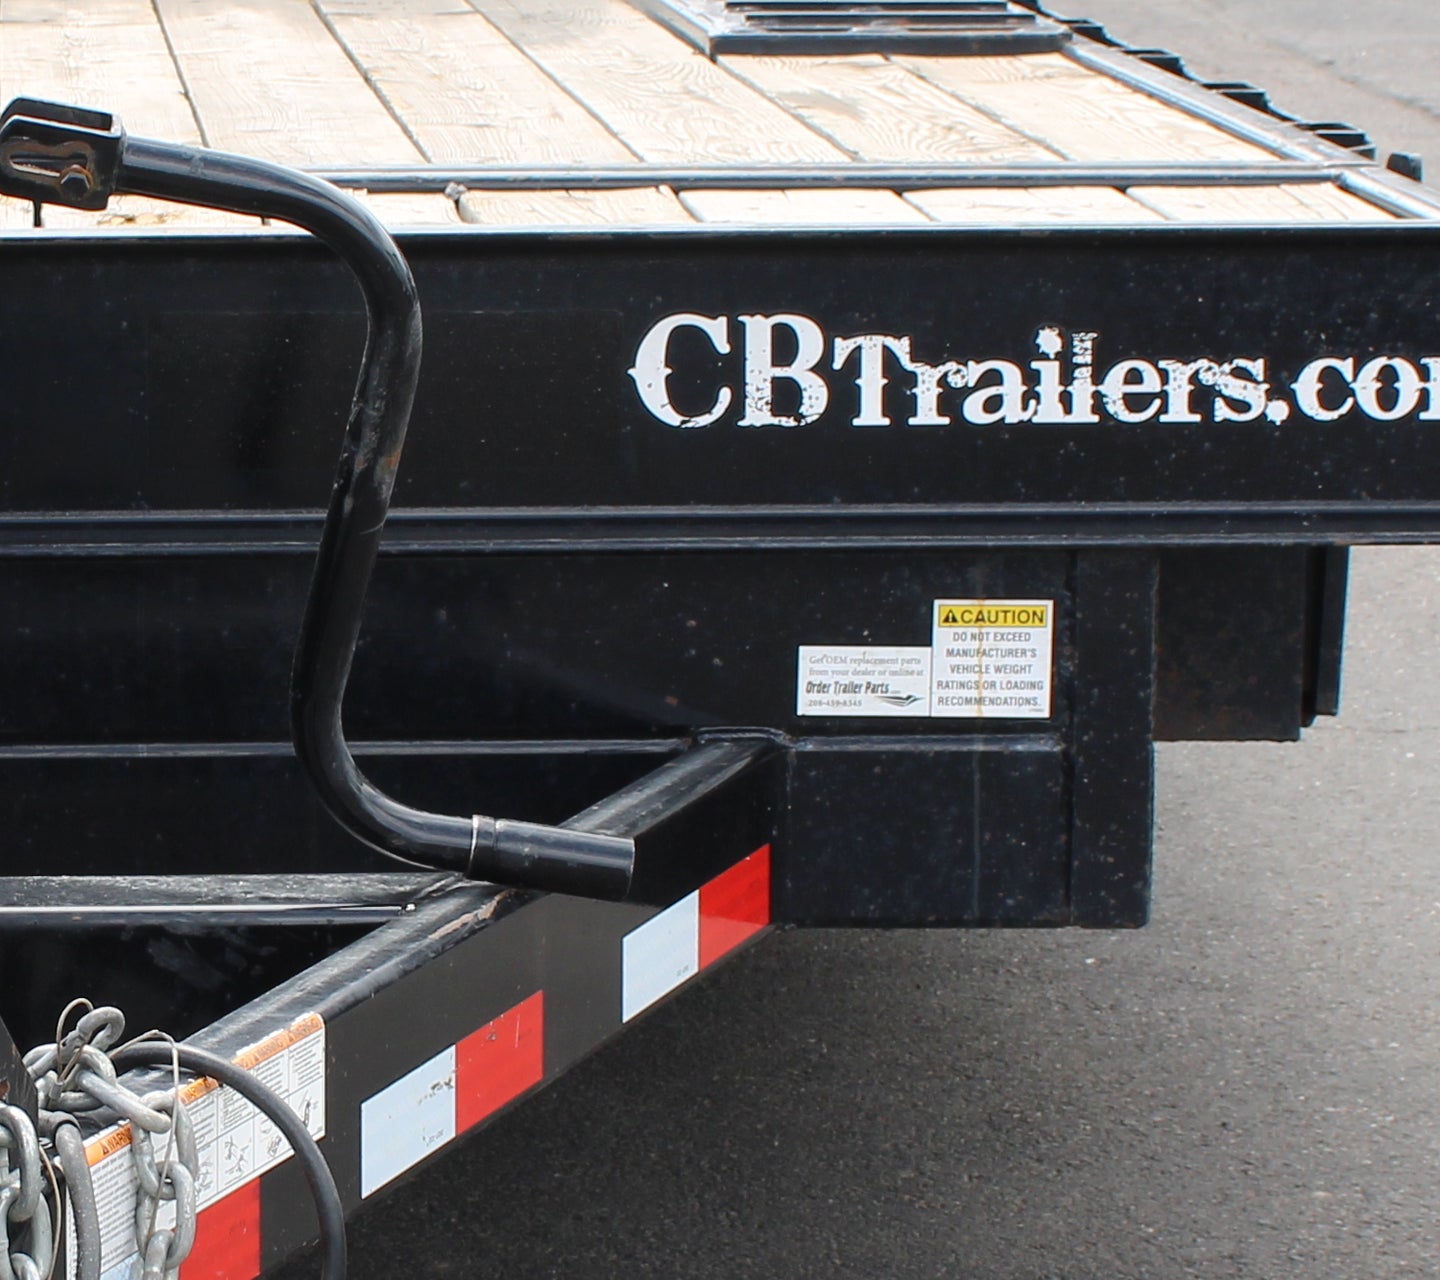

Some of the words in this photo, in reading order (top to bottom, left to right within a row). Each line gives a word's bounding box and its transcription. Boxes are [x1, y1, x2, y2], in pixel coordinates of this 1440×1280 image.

[960, 609, 1045, 624] CAUTION
[953, 632, 967, 642] DO
[970, 632, 991, 642] NOT
[993, 631, 1031, 642] EXCEED
[946, 648, 1037, 658] MANUFACTURER'S
[826, 656, 848, 665] OEM
[850, 655, 900, 667] replacement
[901, 656, 922, 667] parts
[809, 669, 829, 677] from
[830, 670, 850, 679] your
[851, 668, 876, 677] dealer
[879, 669, 887, 677] or
[888, 668, 915, 677] online
[916, 669, 924, 677] at
[949, 664, 991, 674] VEHICLE
[993, 664, 1033, 674] WEIGHT
[806, 681, 831, 694] Order
[833, 681, 863, 695] Trailer
[864, 681, 890, 694] Parts
[937, 680, 980, 690] RATINGS
[982, 680, 997, 690] OR
[1000, 681, 1044, 690] LOADING
[937, 696, 1042, 707] RECOMMENDATIONS.
